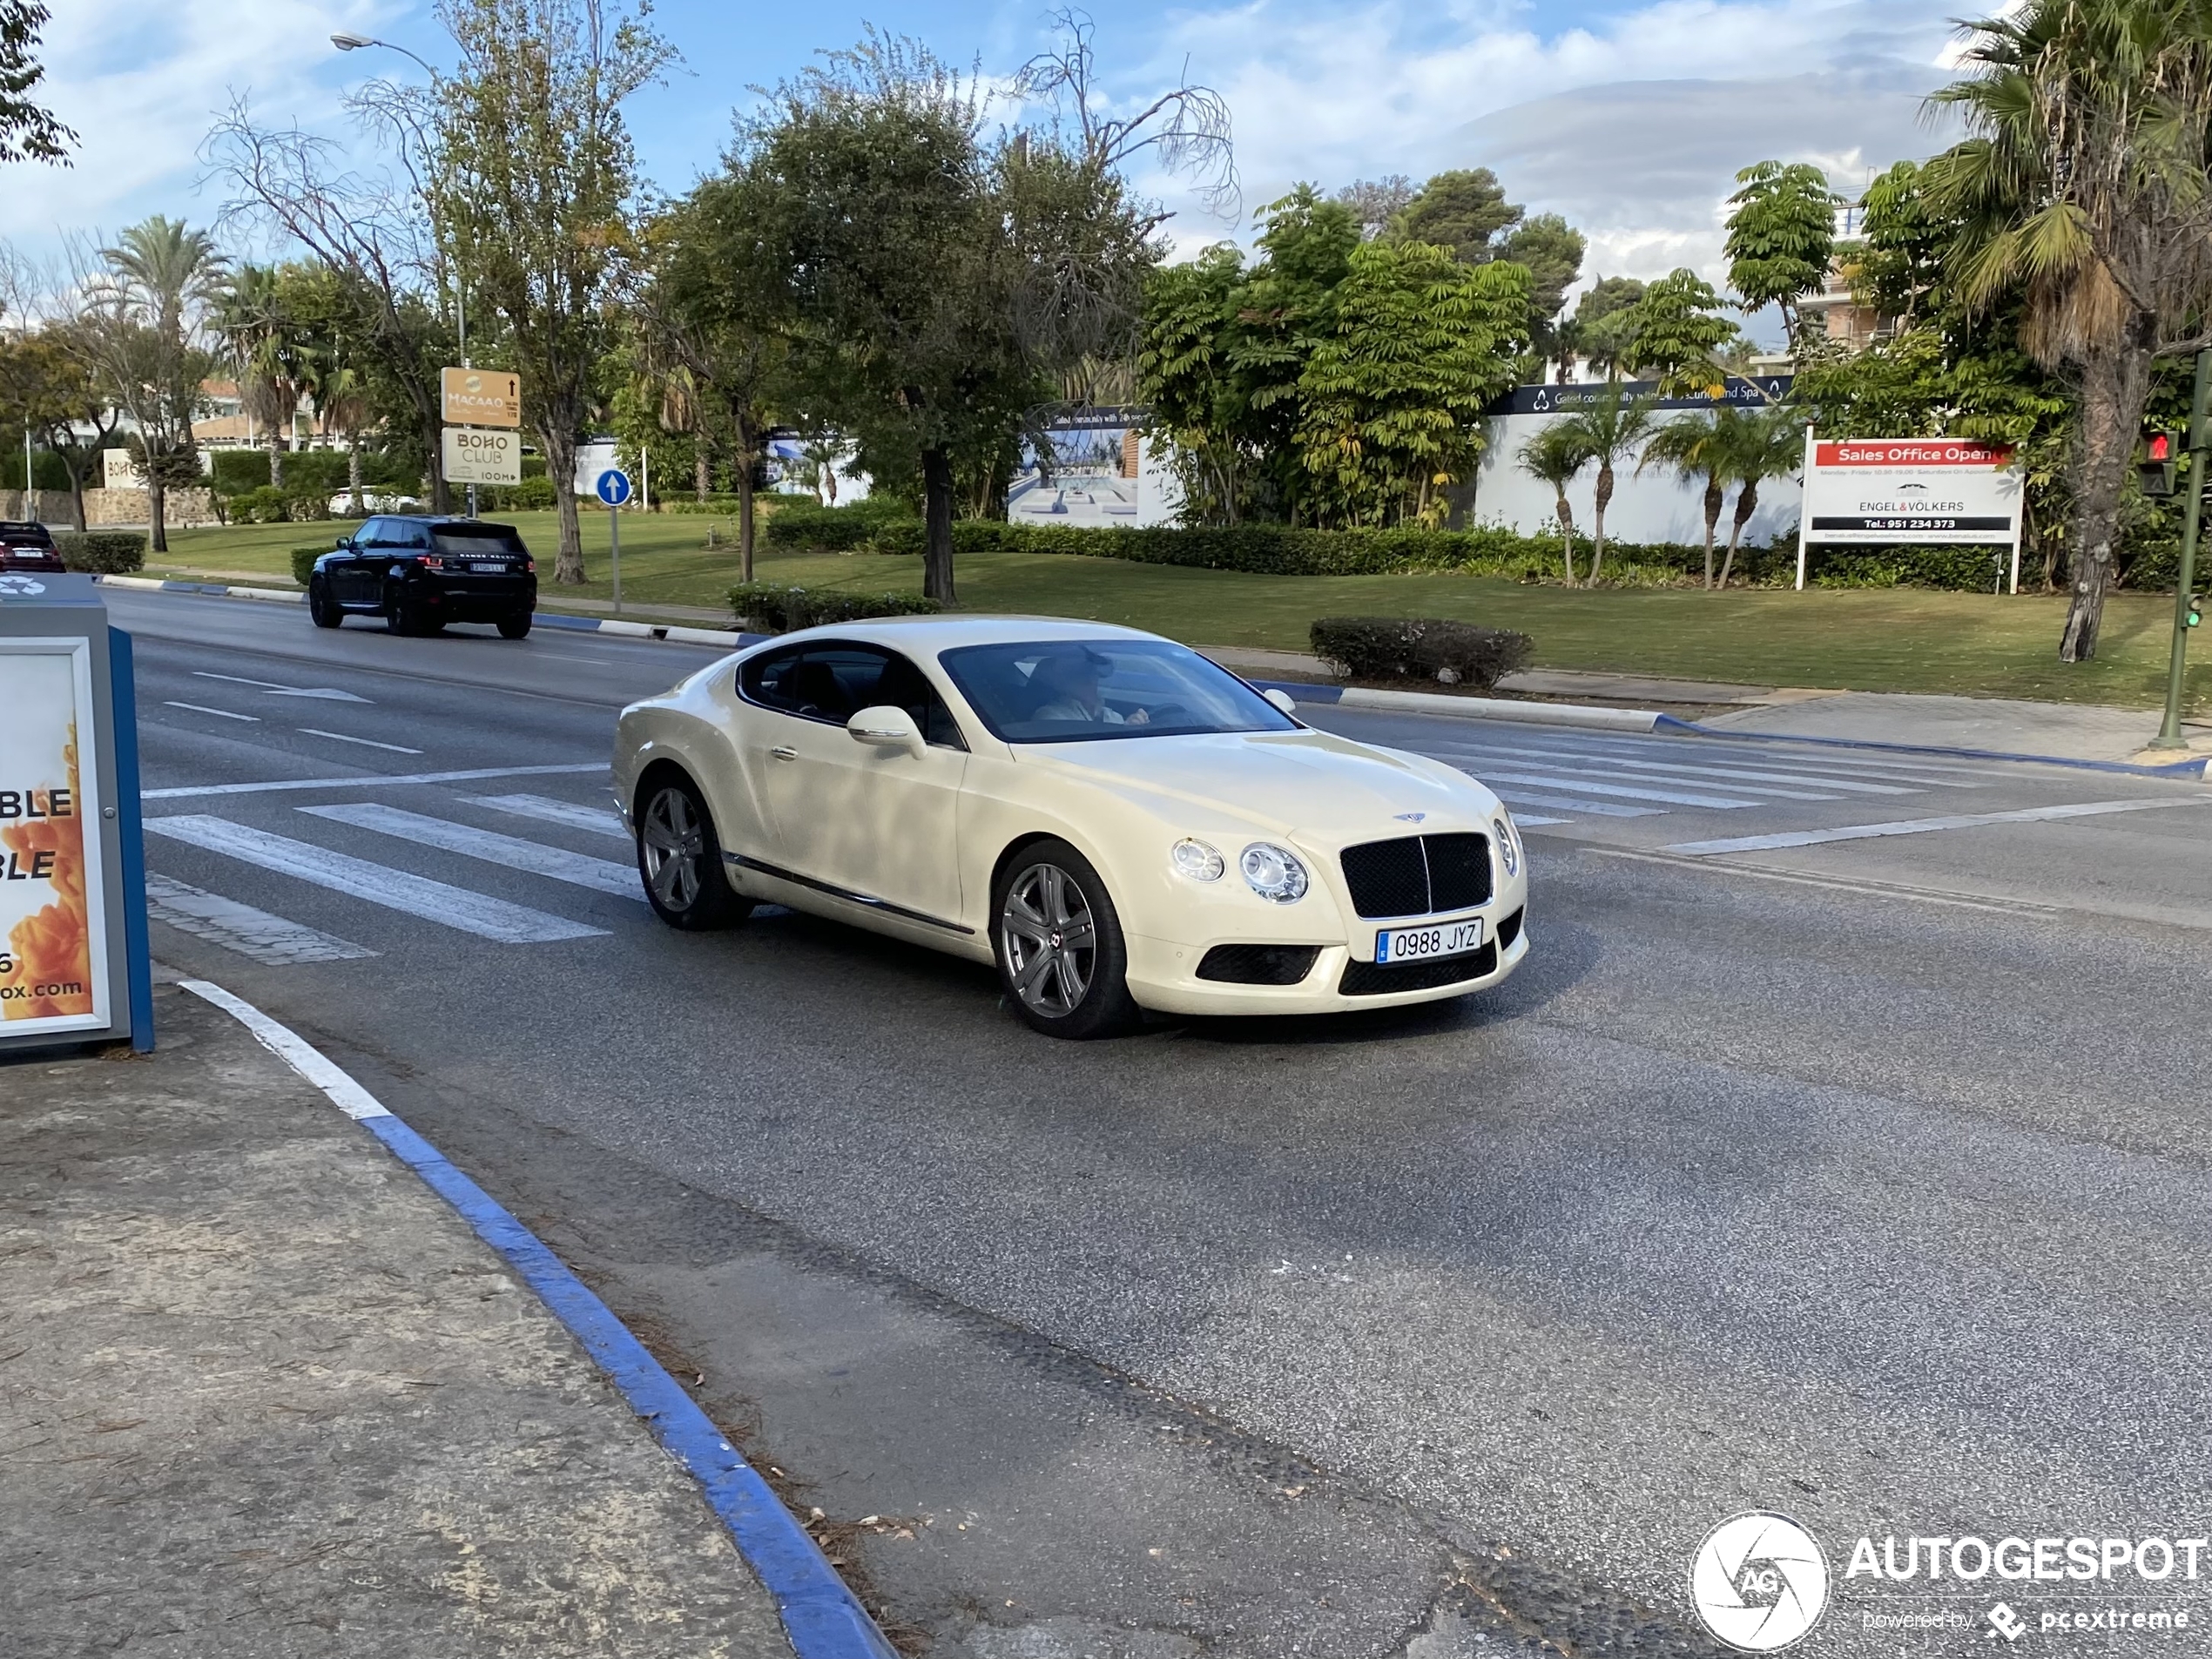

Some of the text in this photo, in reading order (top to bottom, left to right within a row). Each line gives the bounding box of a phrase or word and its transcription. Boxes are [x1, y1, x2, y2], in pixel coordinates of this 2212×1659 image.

[447, 392, 503, 408] MACAAO
[1740, 385, 1758, 401] Spa
[457, 434, 508, 449] BOHO
[462, 448, 502, 464] CLUB
[1838, 447, 1993, 462] Sales Office Open
[1887, 519, 1907, 529] 951
[1910, 519, 1932, 529] 234
[1932, 519, 1956, 529] 373
[0, 850, 56, 881] LE
[1395, 923, 1476, 957] 0988 JYZ
